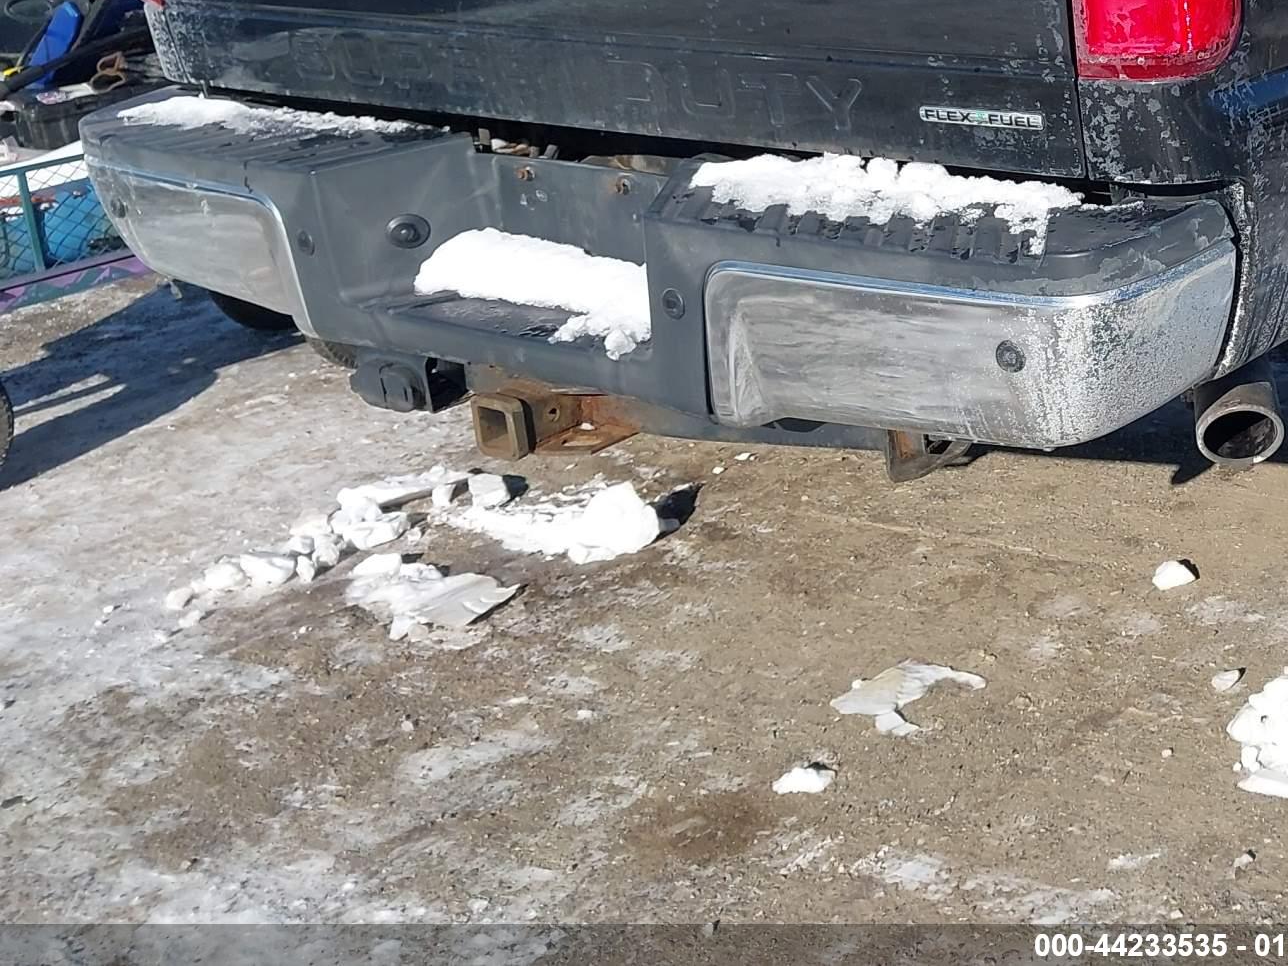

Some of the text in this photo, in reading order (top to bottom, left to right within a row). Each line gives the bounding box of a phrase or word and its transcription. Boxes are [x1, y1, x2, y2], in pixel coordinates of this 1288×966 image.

[602, 55, 864, 132] DUTY
[924, 109, 1039, 129] FLEX FUEL
